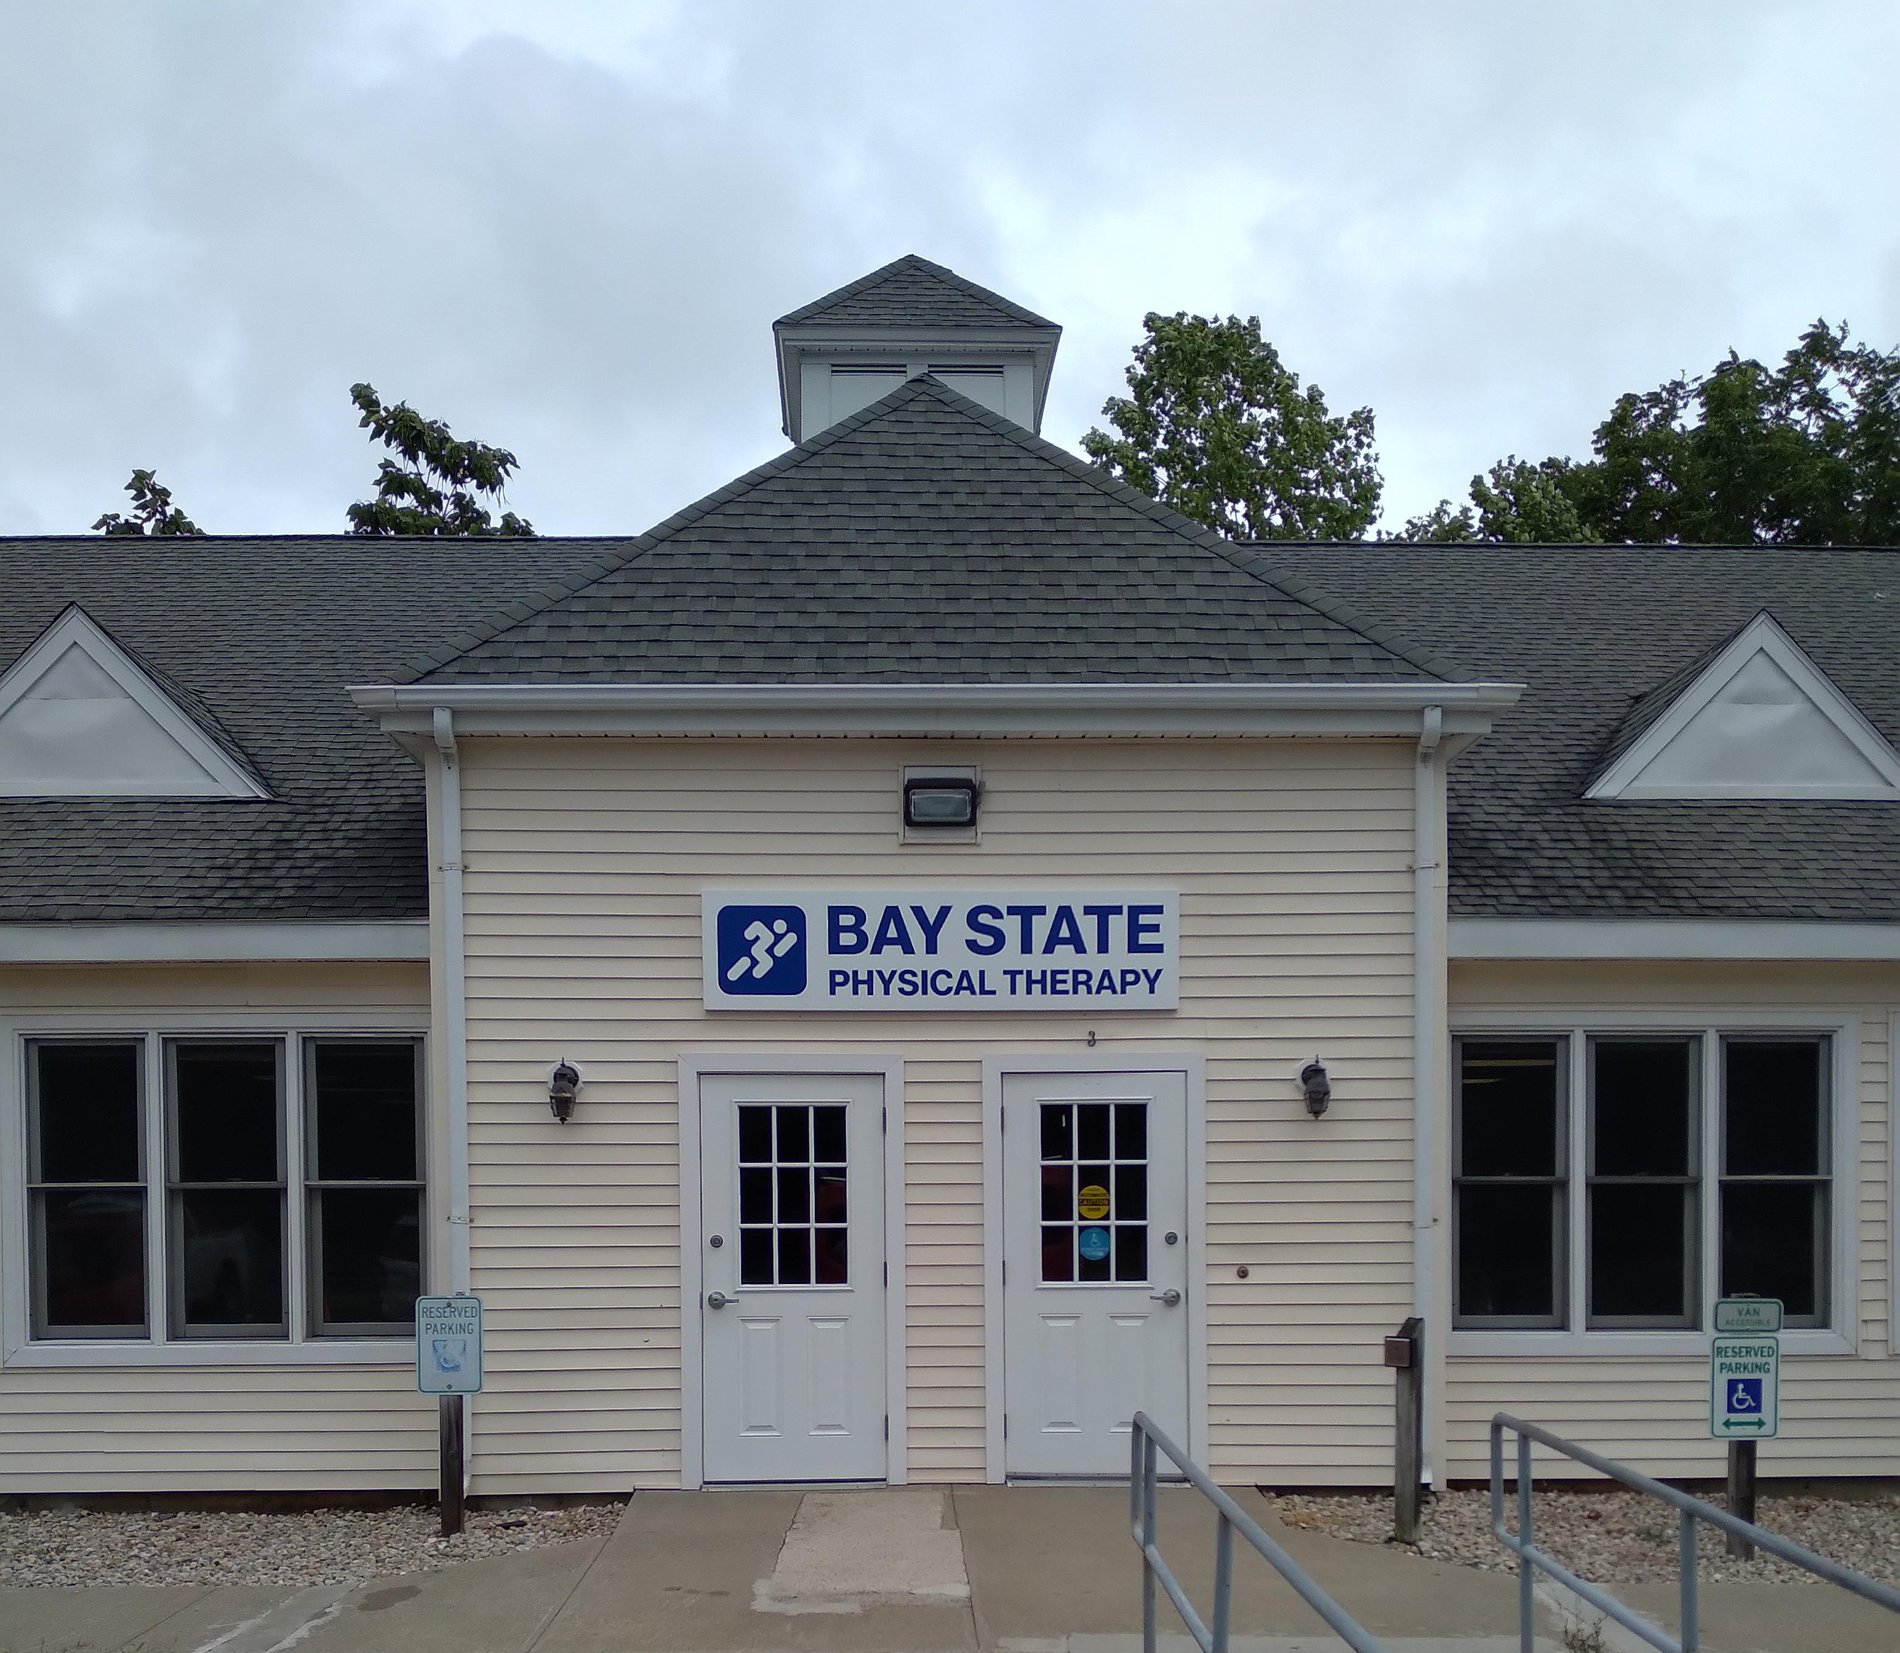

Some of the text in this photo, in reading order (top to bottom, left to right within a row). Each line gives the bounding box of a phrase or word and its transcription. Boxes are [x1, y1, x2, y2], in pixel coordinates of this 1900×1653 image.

[827, 904, 1165, 957] BAY STATE
[828, 968, 1164, 997] PHYSICAL THERAPY
[421, 1306, 478, 1319] RESERVED
[1737, 1307, 1761, 1317] VAN
[425, 1322, 474, 1335] PARKING
[1725, 1318, 1771, 1327] ACCESSIBLE
[1716, 1345, 1775, 1359] RESERVED
[1719, 1361, 1771, 1375] PARKING
